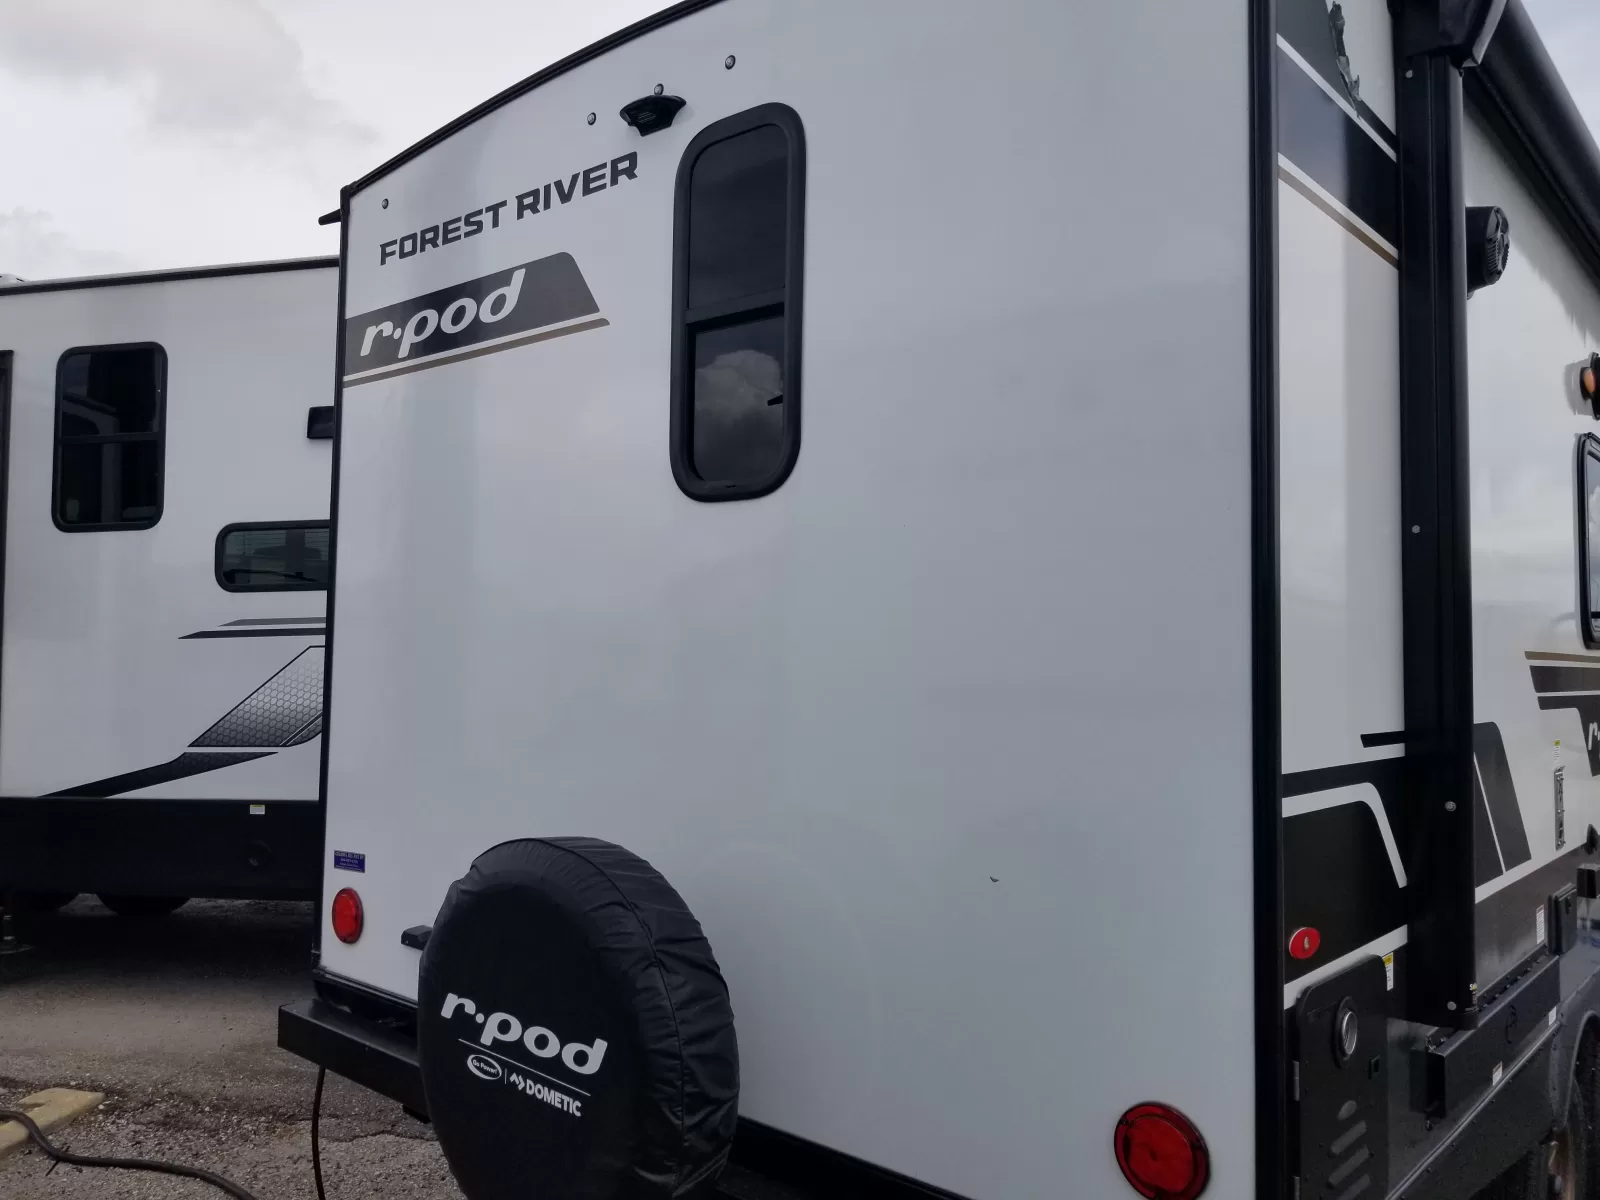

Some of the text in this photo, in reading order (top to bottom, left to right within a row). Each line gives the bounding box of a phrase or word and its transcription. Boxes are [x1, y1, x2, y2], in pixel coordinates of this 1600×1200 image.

[380, 151, 638, 266] FOREST RIVER
[526, 1079, 581, 1117] DOMETIC
